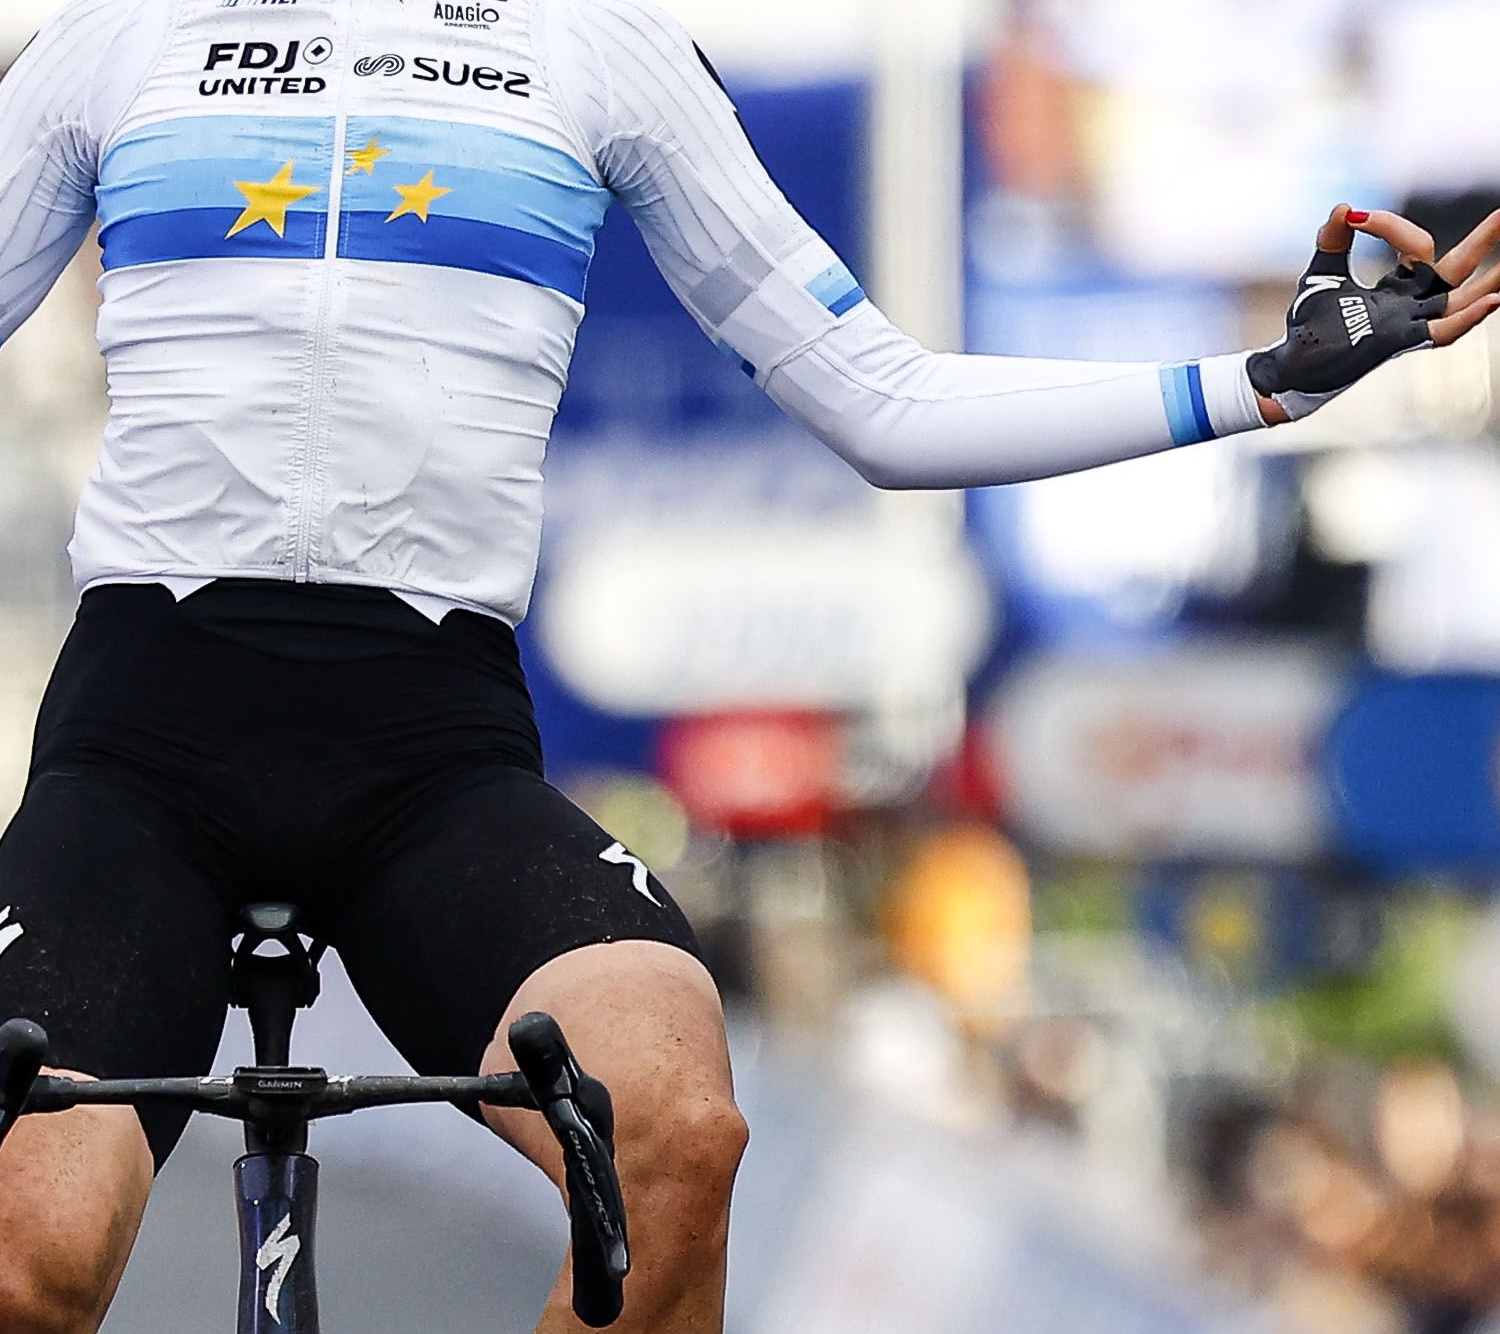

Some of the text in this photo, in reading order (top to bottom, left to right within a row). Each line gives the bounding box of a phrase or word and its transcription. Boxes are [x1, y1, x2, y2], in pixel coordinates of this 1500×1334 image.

[203, 40, 300, 74] FDJ
[198, 76, 327, 97] UNITED
[1338, 296, 1374, 347] GOBIK
[257, 1078, 303, 1089] GARMIN
